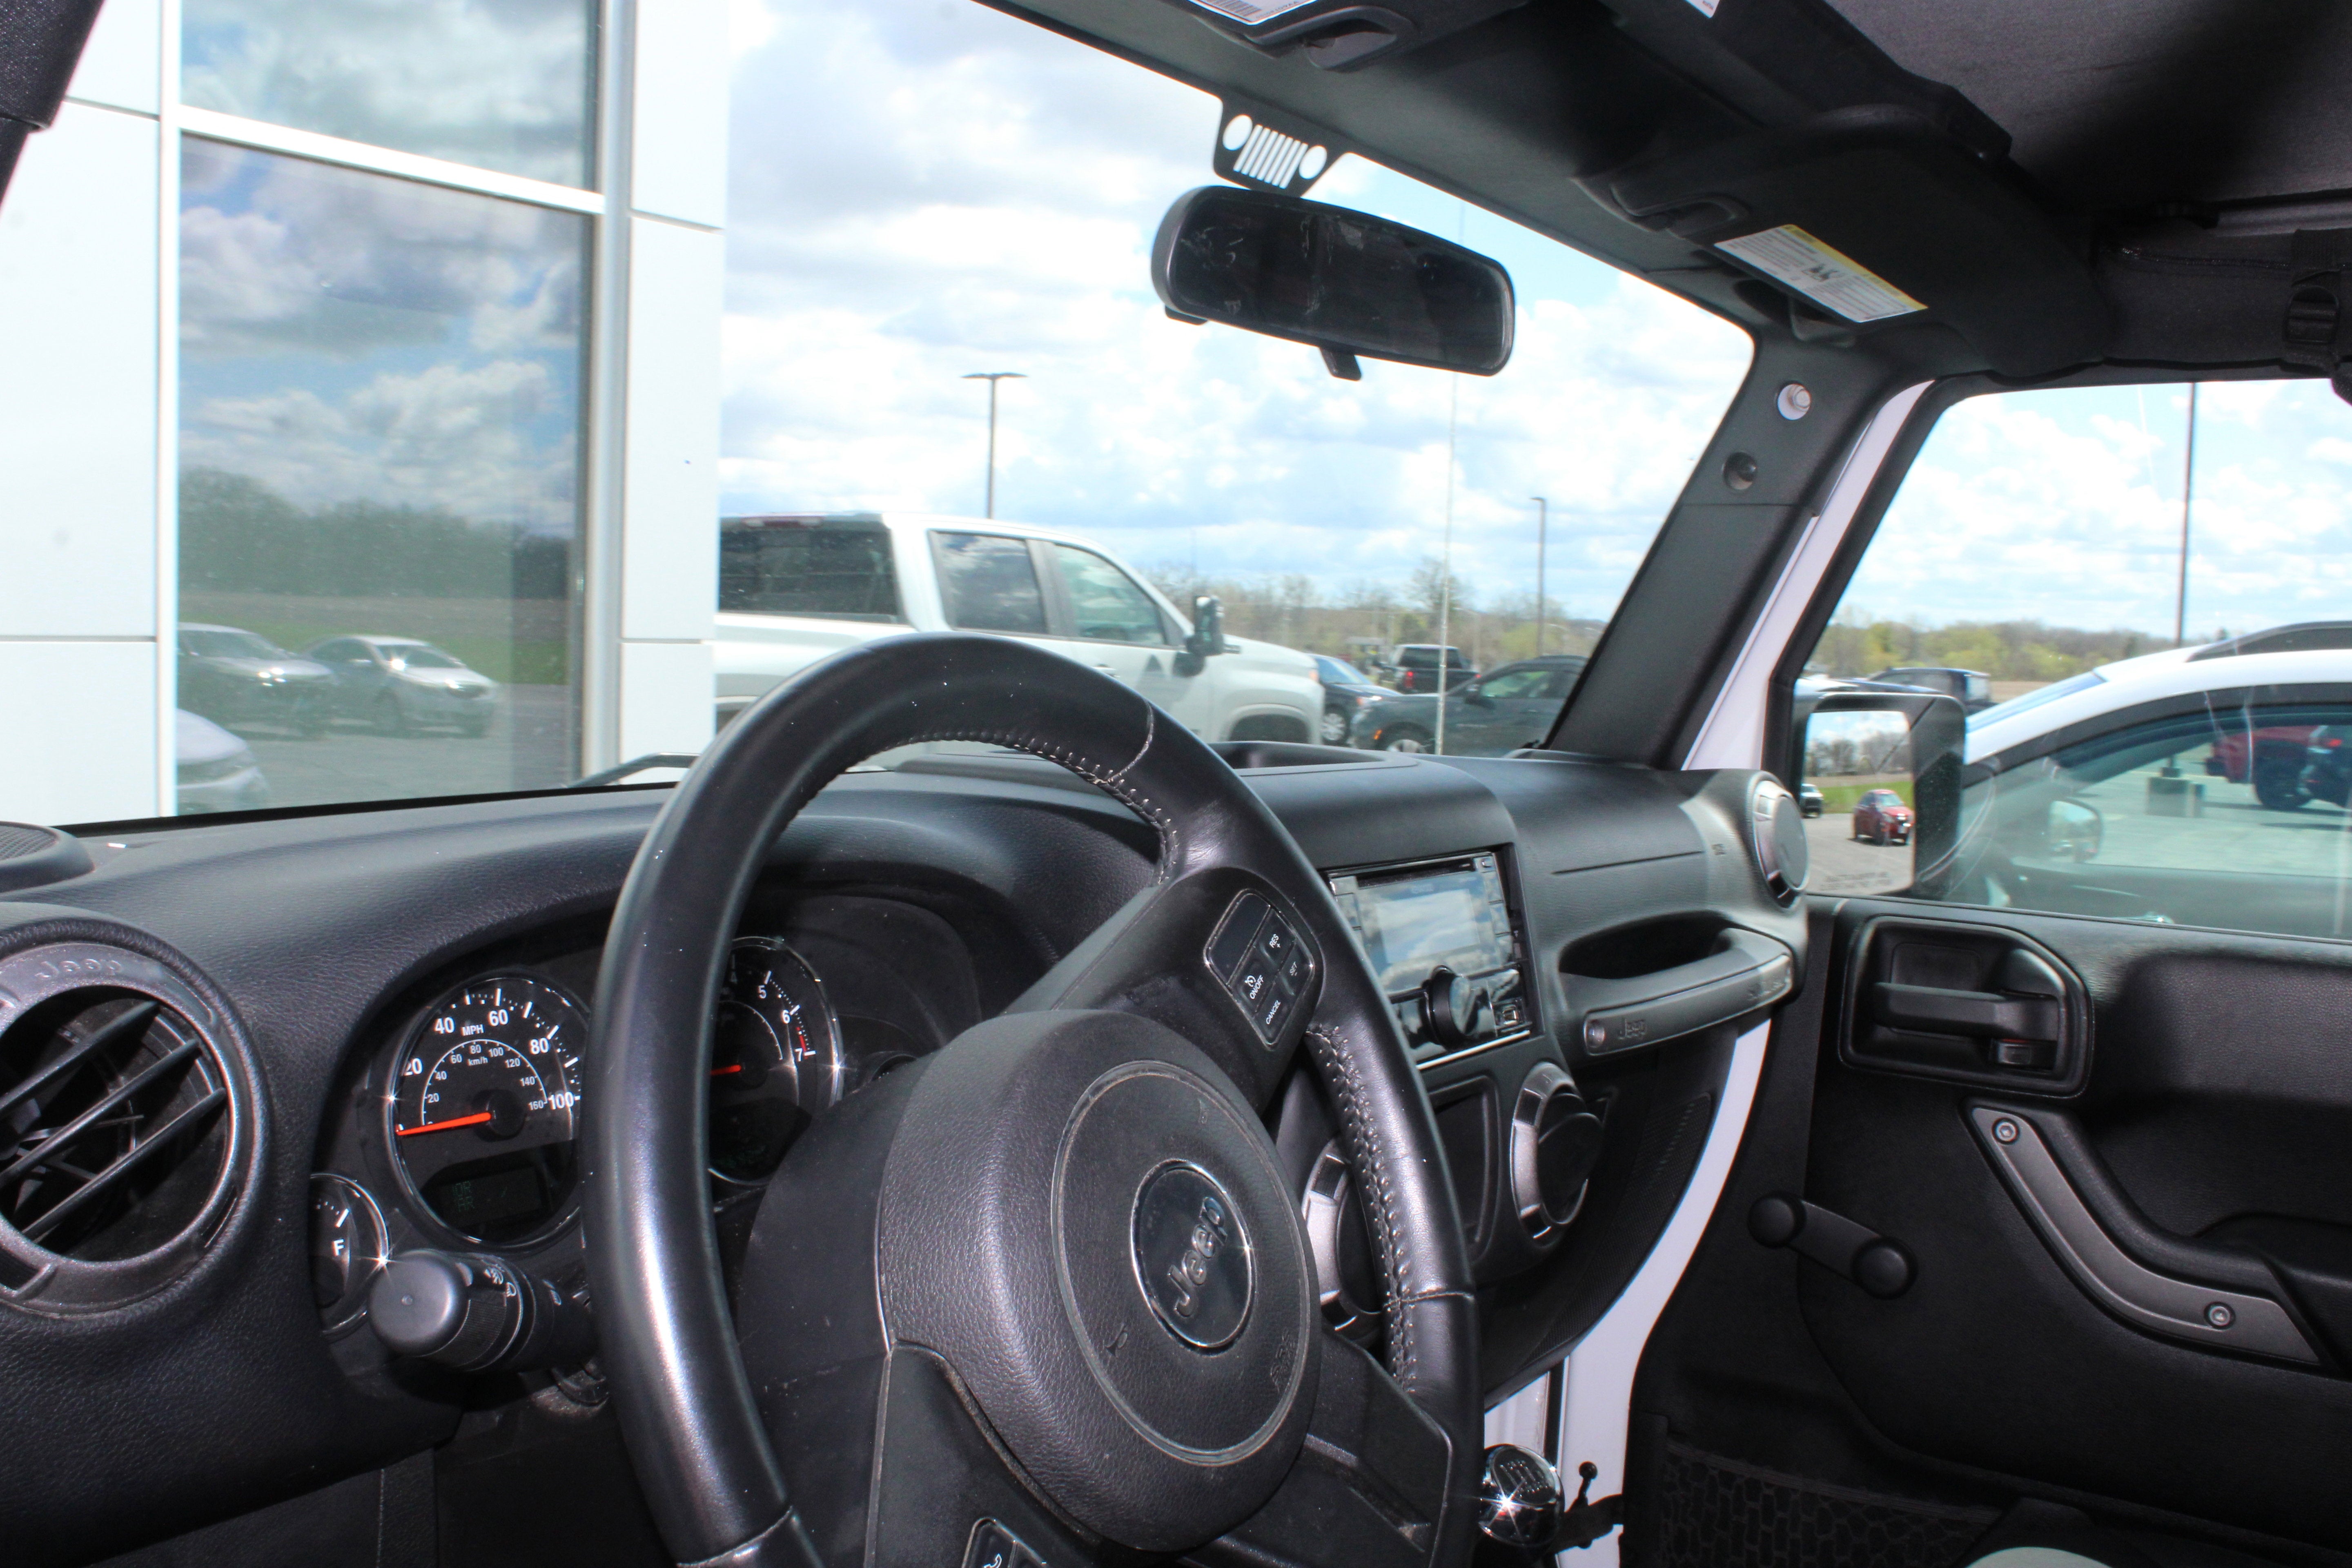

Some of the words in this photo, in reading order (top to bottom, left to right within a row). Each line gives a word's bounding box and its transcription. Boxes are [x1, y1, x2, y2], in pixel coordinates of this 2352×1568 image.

[1269, 934, 1279, 949] RES
[36, 959, 122, 978] Jeep
[1290, 961, 1298, 975] SET
[758, 985, 767, 998] 5
[1250, 975, 1264, 1000] ON/OFF
[488, 1009, 509, 1027] 60
[782, 1009, 791, 1024] 6
[1266, 1000, 1281, 1025] CANCEL
[434, 1017, 455, 1034] 40
[461, 1024, 485, 1036] MPH
[470, 1044, 482, 1054] 80
[488, 1047, 504, 1058] 100
[530, 1037, 550, 1055] 80
[450, 1054, 463, 1064] 60
[468, 1056, 488, 1066] km/h
[795, 1048, 803, 1062] 7
[505, 1058, 521, 1068] 120
[435, 1071, 448, 1081] 40
[520, 1076, 535, 1087] 140
[428, 1093, 440, 1103] 20
[548, 1091, 574, 1110] 100
[528, 1100, 545, 1111] 160
[332, 1238, 345, 1256] F
[1167, 1196, 1228, 1317] Jeep
